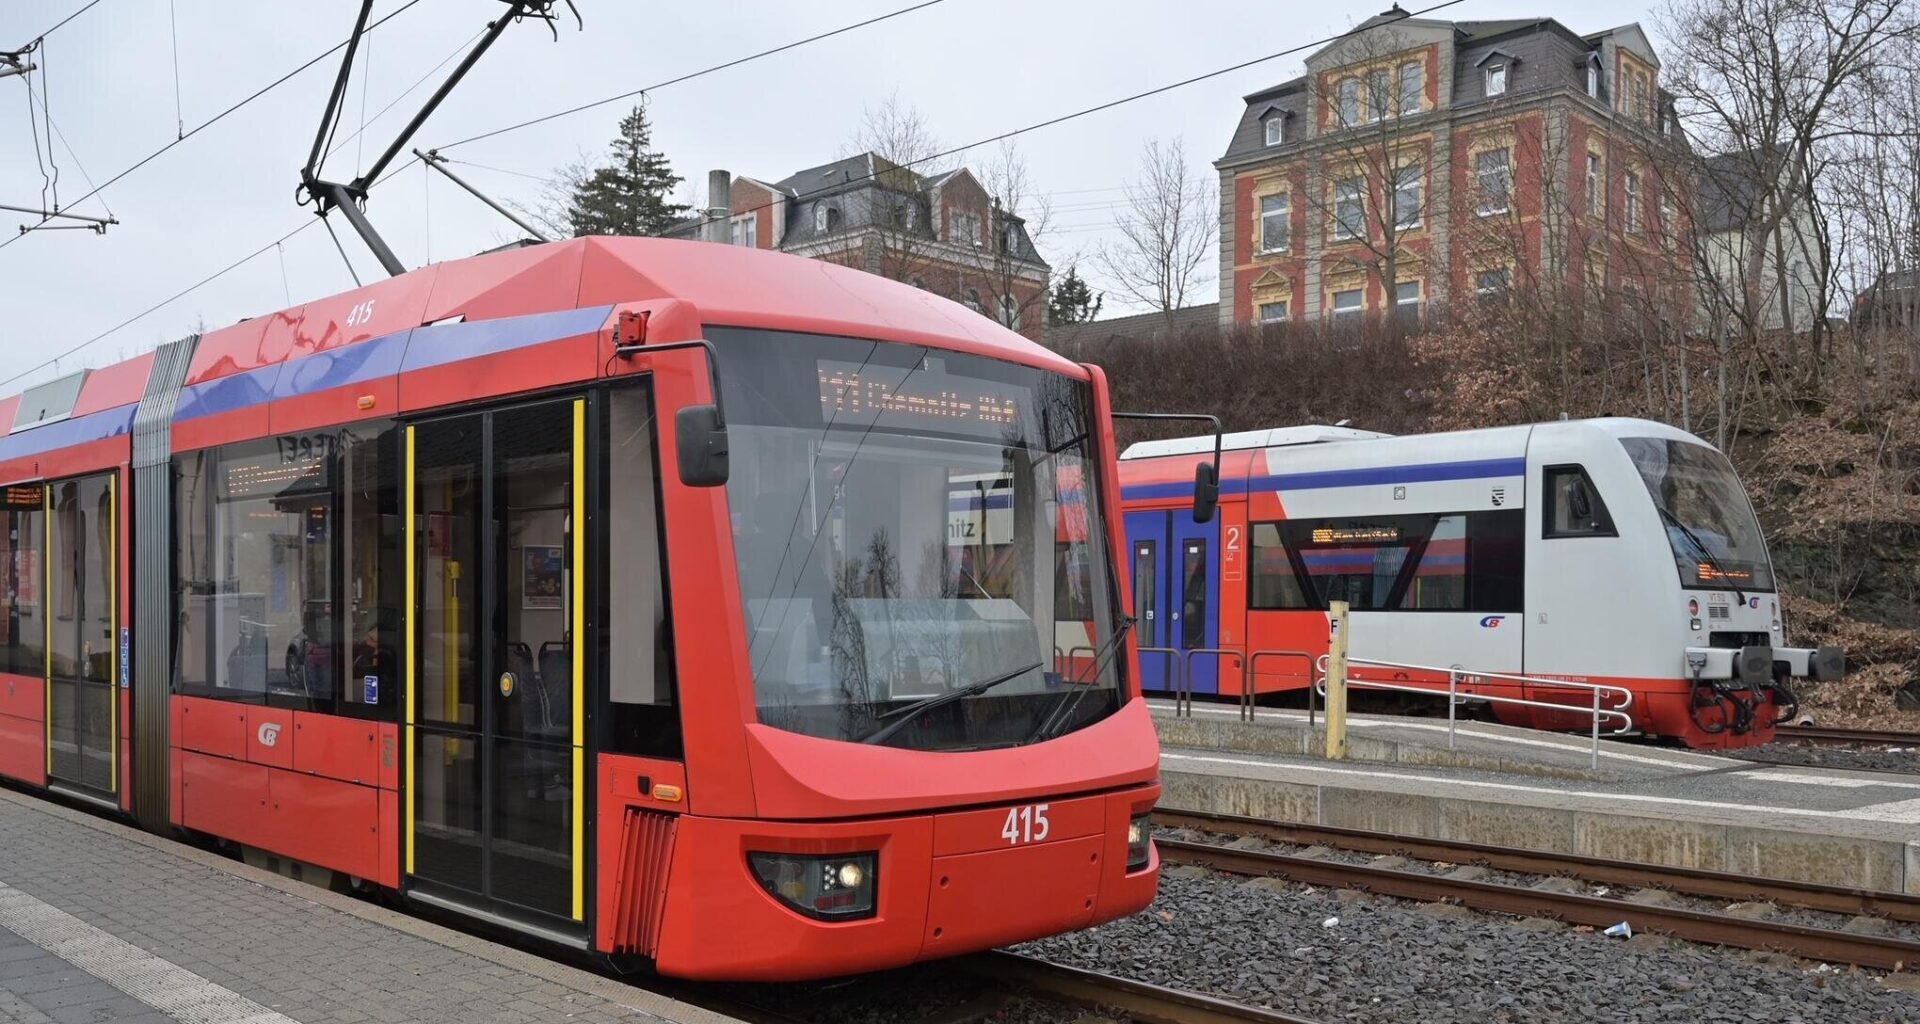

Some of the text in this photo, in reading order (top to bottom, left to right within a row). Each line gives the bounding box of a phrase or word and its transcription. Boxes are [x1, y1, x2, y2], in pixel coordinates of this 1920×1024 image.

[346, 299, 375, 327] 415
[1227, 527, 1239, 549] 2
[1331, 619, 1338, 633] F
[1001, 804, 1049, 845] 415
